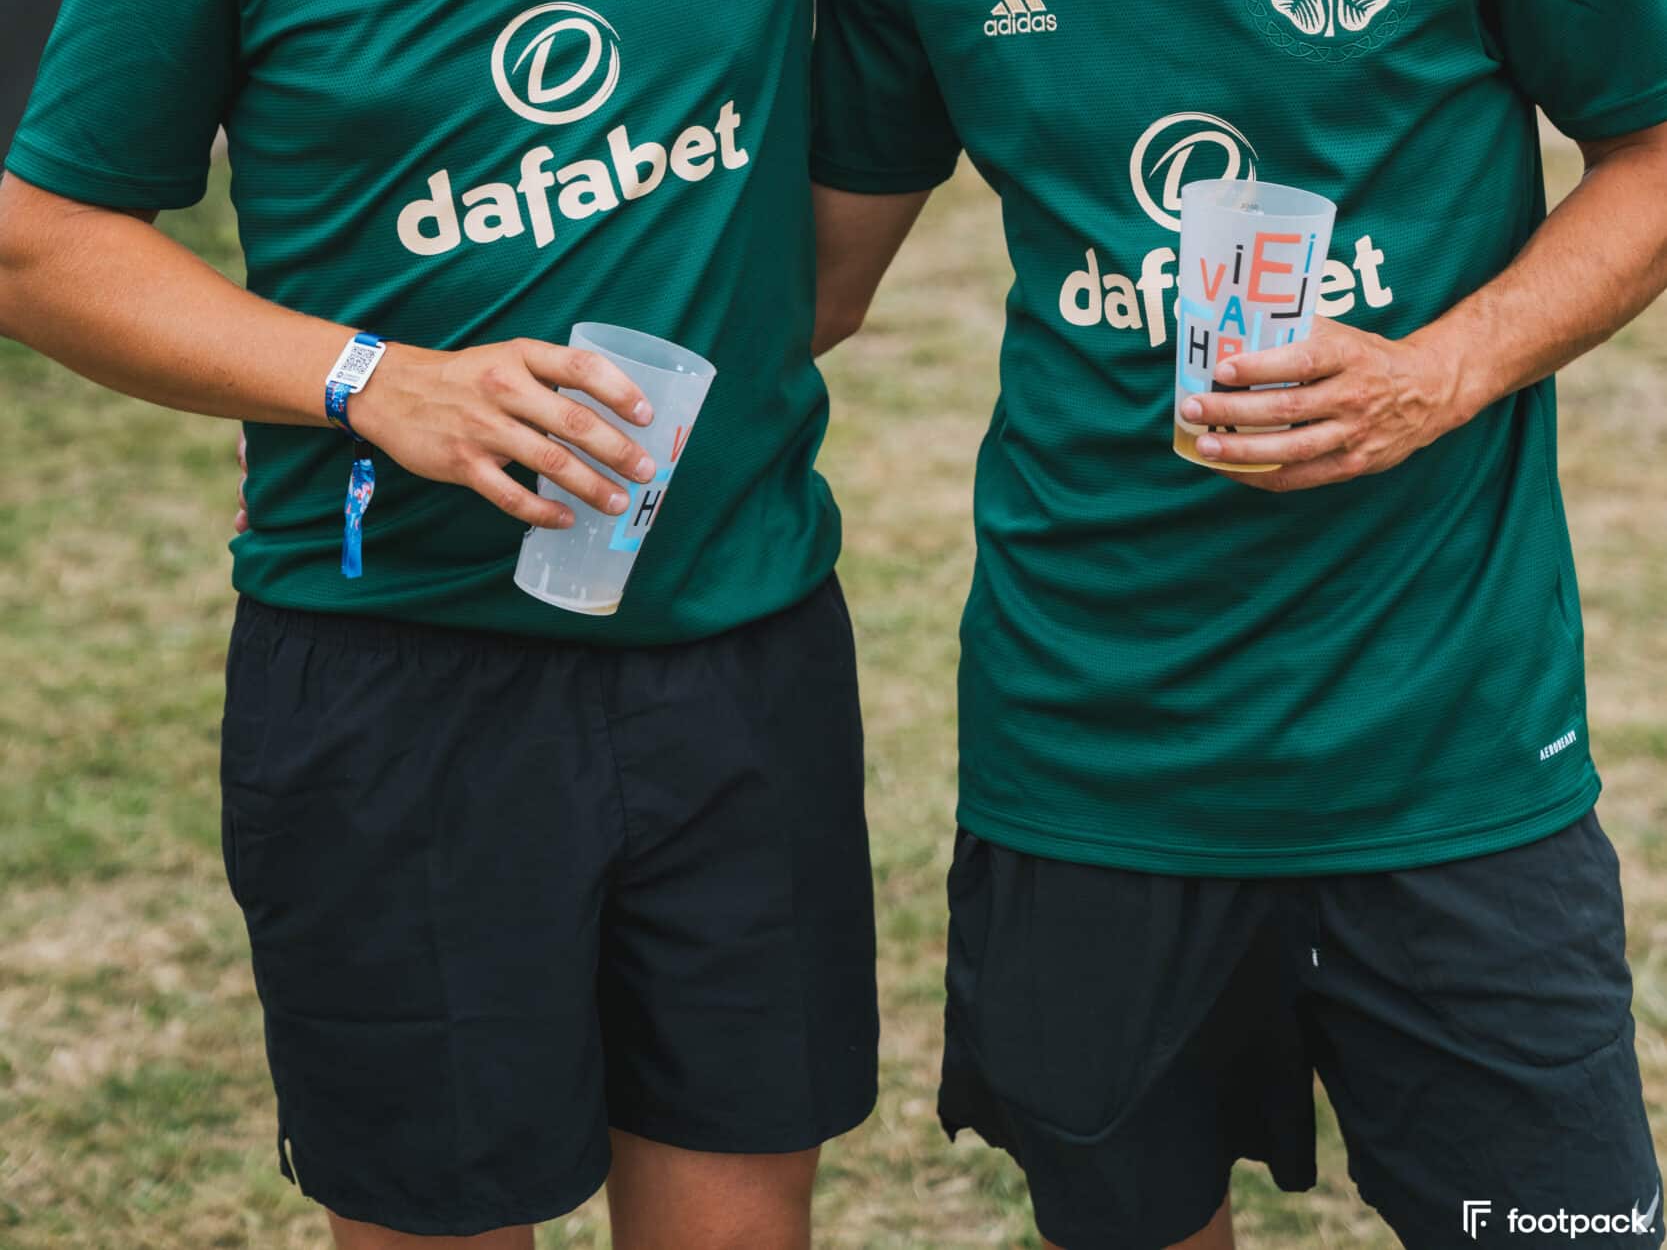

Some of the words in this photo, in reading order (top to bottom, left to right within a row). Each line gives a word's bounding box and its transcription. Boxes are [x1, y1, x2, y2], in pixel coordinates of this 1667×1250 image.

[984, 12, 1057, 36] adidas
[396, 99, 750, 256] dafabet
[1058, 234, 1394, 349] dafet
